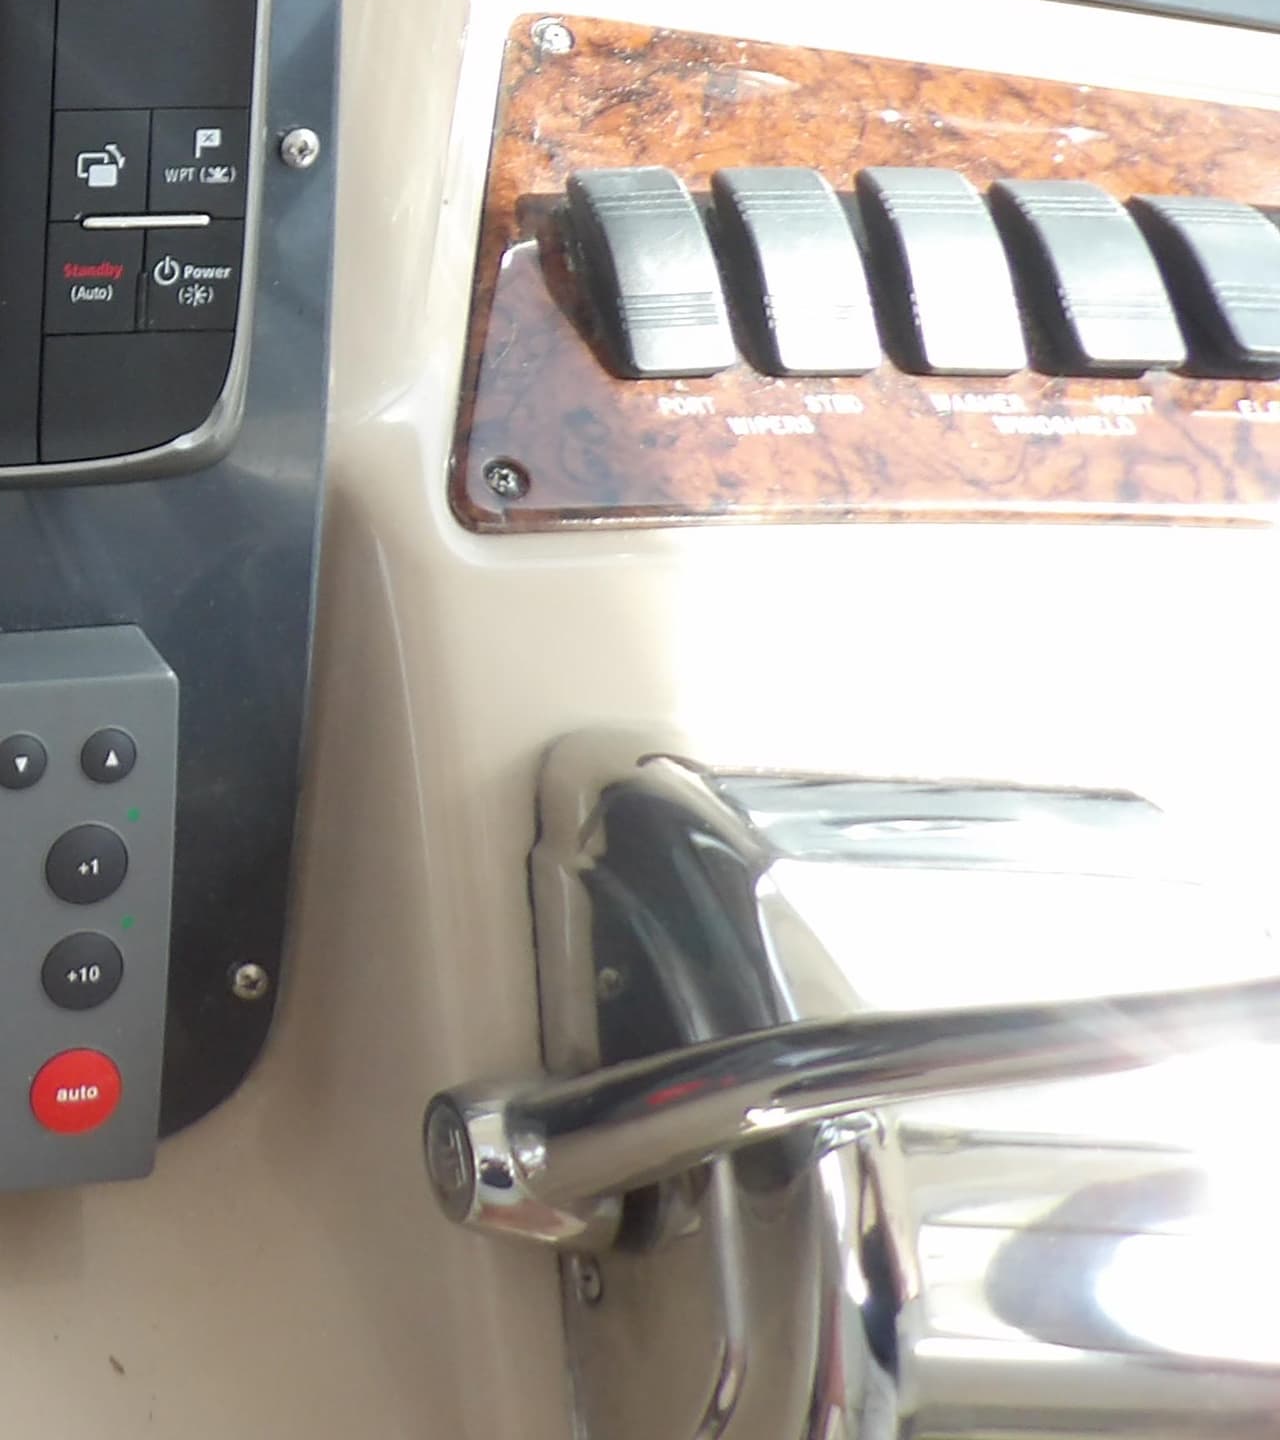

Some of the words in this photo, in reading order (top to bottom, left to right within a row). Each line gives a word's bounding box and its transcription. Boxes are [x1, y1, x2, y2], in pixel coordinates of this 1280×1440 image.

[164, 167, 196, 183] WPT
[63, 261, 124, 280] Standby
[183, 265, 233, 279] Power
[70, 284, 114, 303] (Auto)
[658, 396, 716, 416] PORT
[725, 415, 816, 436] WIPERS
[77, 858, 100, 876] +1
[66, 964, 101, 984] +10
[55, 1083, 99, 1103] auto
